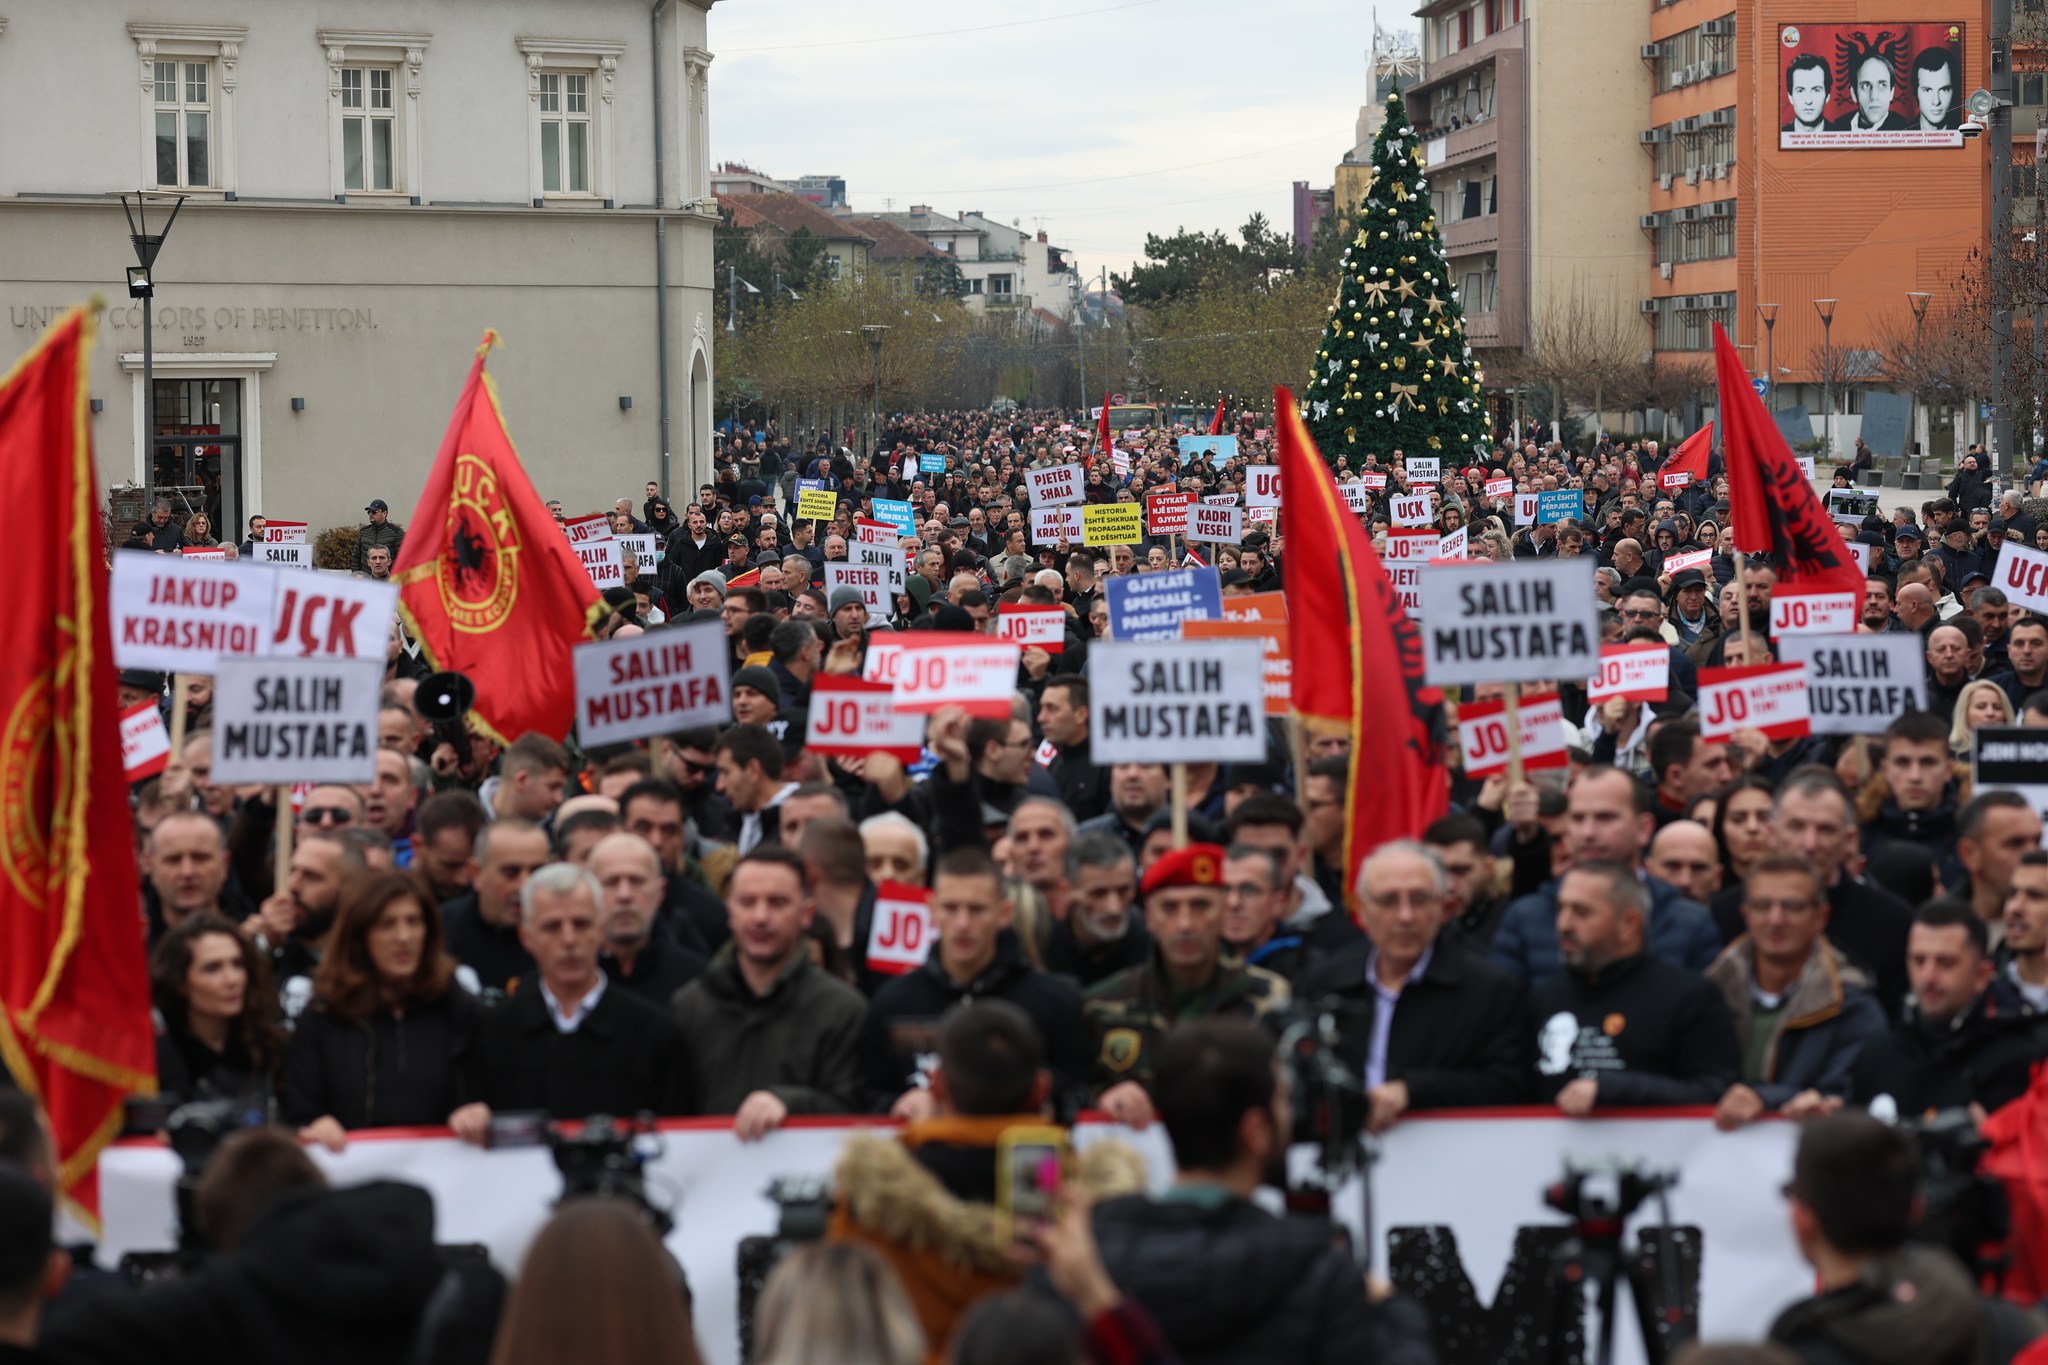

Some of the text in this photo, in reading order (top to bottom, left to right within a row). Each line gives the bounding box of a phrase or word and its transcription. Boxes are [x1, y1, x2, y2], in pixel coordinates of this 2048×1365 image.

[214, 307, 245, 329] OF
[1034, 469, 1072, 486] PJETËR
[1409, 470, 1438, 478] MUSTAFA
[1666, 476, 1675, 484] JO
[1040, 485, 1073, 500] SHALA
[1340, 488, 1356, 498] ALIH
[1488, 484, 1497, 494] JO
[1557, 492, 1578, 501] ËSHTË
[1156, 495, 1188, 505] GJYKATË
[1346, 498, 1364, 508] TAFA
[1542, 502, 1578, 511] PËRPJEKJA
[1152, 506, 1166, 514] NJË
[1198, 510, 1231, 523] KADRI
[1250, 509, 1261, 520] JO
[1397, 500, 1425, 520] UÇK
[1084, 516, 1106, 524] ËSHTË
[1088, 524, 1136, 533] PROPAGANDA
[1152, 525, 1188, 534] SEGREGUE
[266, 528, 282, 542] JO
[572, 526, 588, 542] JO
[859, 528, 874, 544] JO
[1196, 523, 1232, 537] VESELI
[620, 540, 646, 552] SALIH
[1388, 540, 1410, 558] JO
[1442, 534, 1464, 556] REXHEP
[266, 549, 298, 562] SALIH
[861, 550, 892, 567] SALIH
[1667, 559, 1684, 570] JO
[586, 564, 620, 580] TAFA
[836, 567, 879, 586] PJETËR
[1385, 566, 1420, 586] PJET
[148, 576, 238, 609] JAKUP
[1126, 572, 1194, 594] GJYKATË
[1123, 592, 1191, 612] SPECIALE
[1460, 579, 1554, 617] SALIH
[1776, 602, 1808, 629] JO
[124, 616, 257, 655] KRASNIQI
[1001, 618, 1027, 640] JO
[1434, 622, 1590, 663] MUSTAFA
[608, 640, 692, 686] SALIH
[1813, 650, 1890, 678] SALIH
[902, 656, 946, 692] JO
[1130, 660, 1222, 695] SALIH
[1593, 661, 1620, 689] JO
[254, 676, 341, 713] SALIH
[587, 675, 723, 727] MUSTAFA
[1808, 685, 1917, 715] USTAFA
[1706, 688, 1748, 726] JO
[815, 700, 859, 734] JO
[1103, 703, 1256, 739] MUSTAFA
[223, 722, 368, 760] MUSTAFA
[1469, 722, 1509, 760] JO
[878, 910, 922, 951] JO
